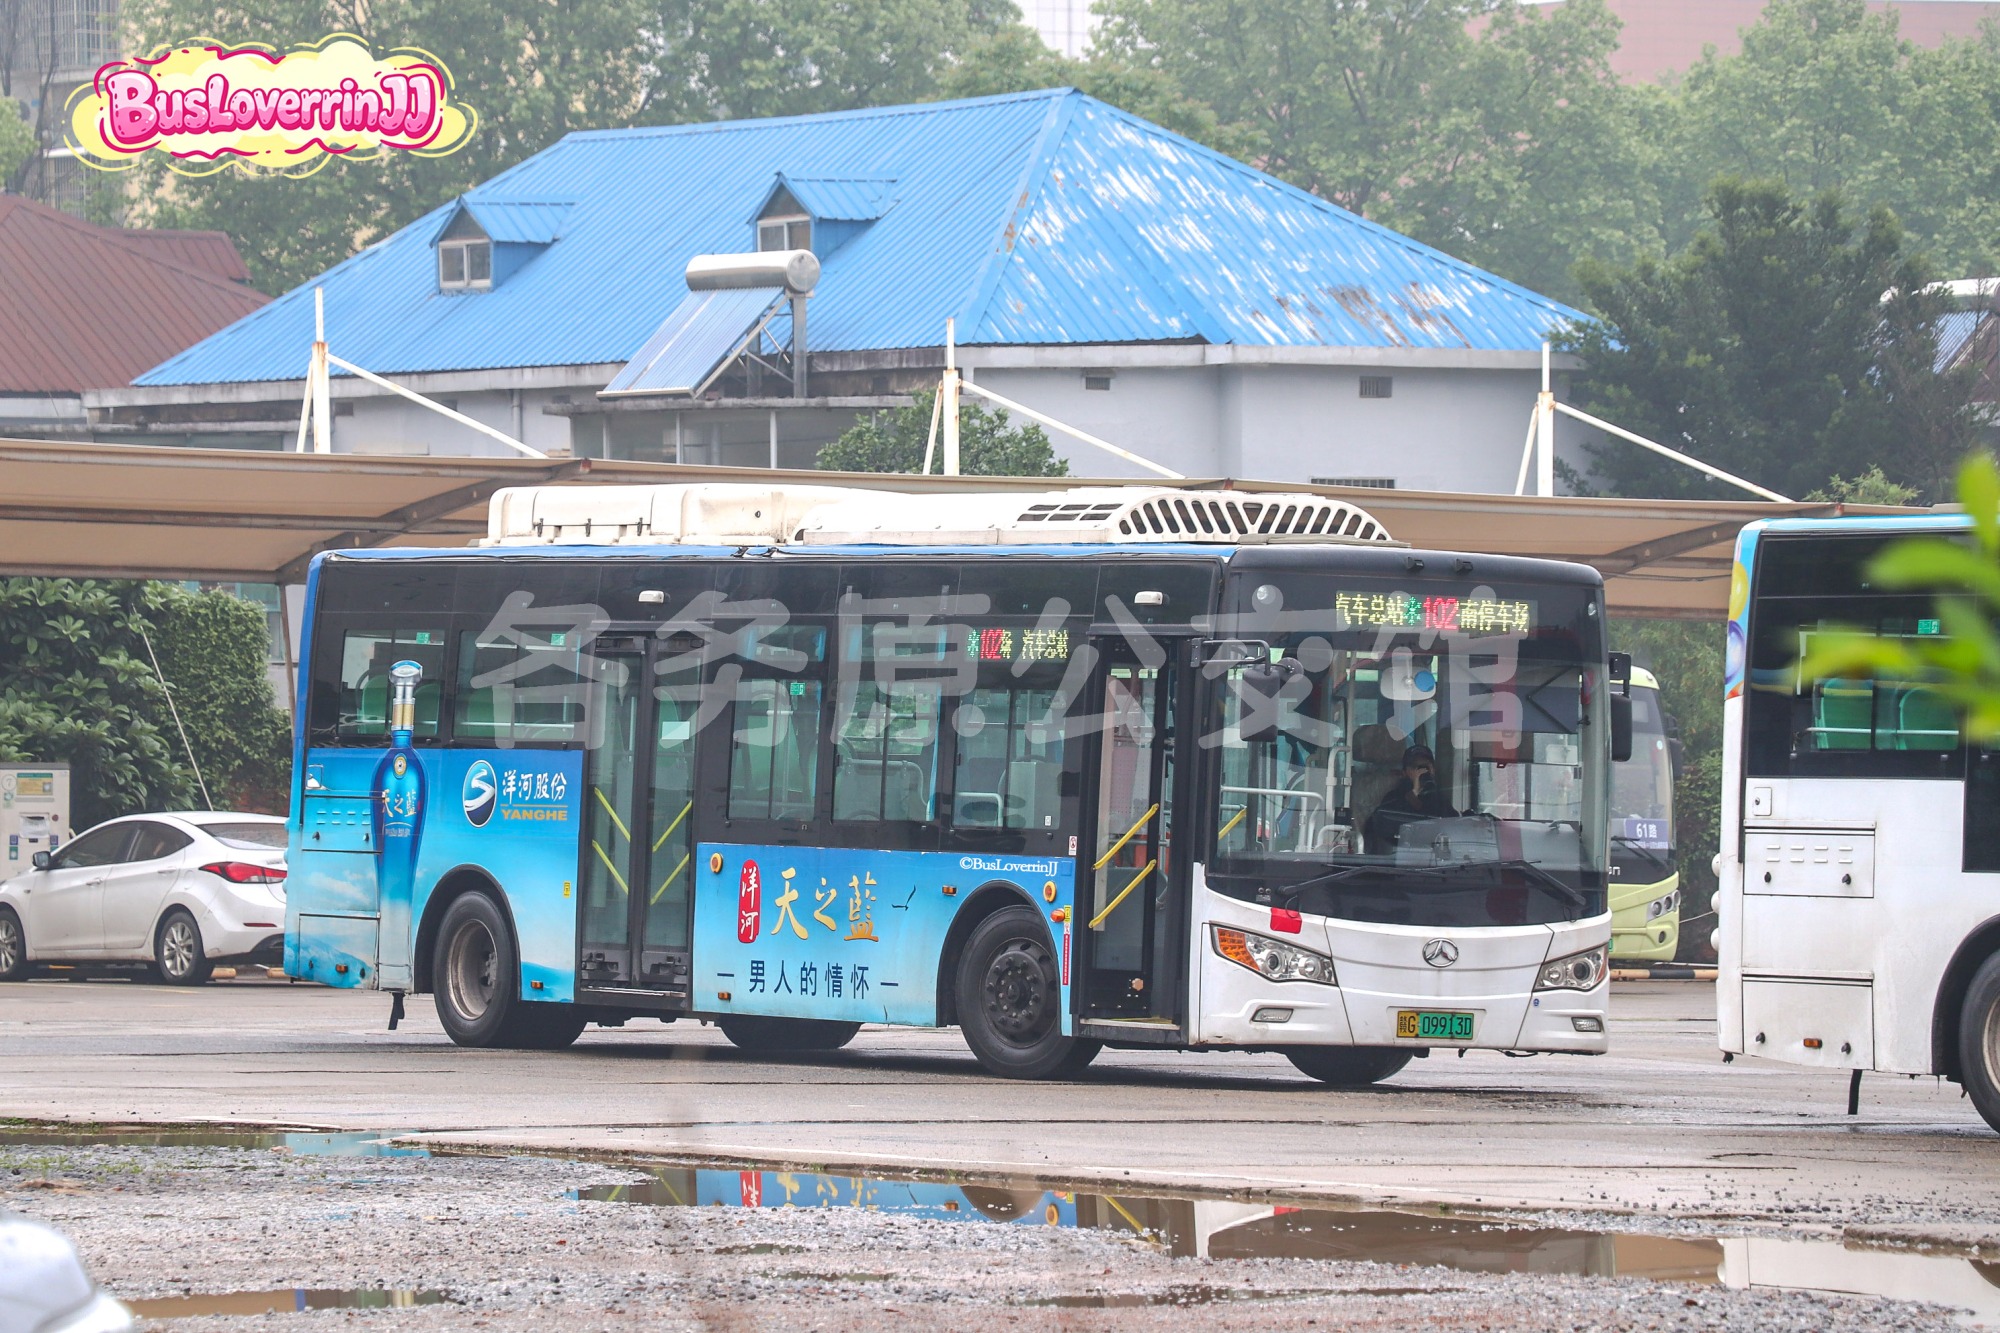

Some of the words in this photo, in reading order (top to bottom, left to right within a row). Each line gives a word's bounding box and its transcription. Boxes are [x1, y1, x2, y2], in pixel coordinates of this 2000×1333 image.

[1335, 592, 1404, 626] 汽车总站
[1422, 596, 1459, 630] 102
[1457, 599, 1530, 632] 南停车场
[501, 769, 568, 805] 洋河股份
[501, 809, 568, 821] YANGHE
[740, 866, 759, 940] 洋河
